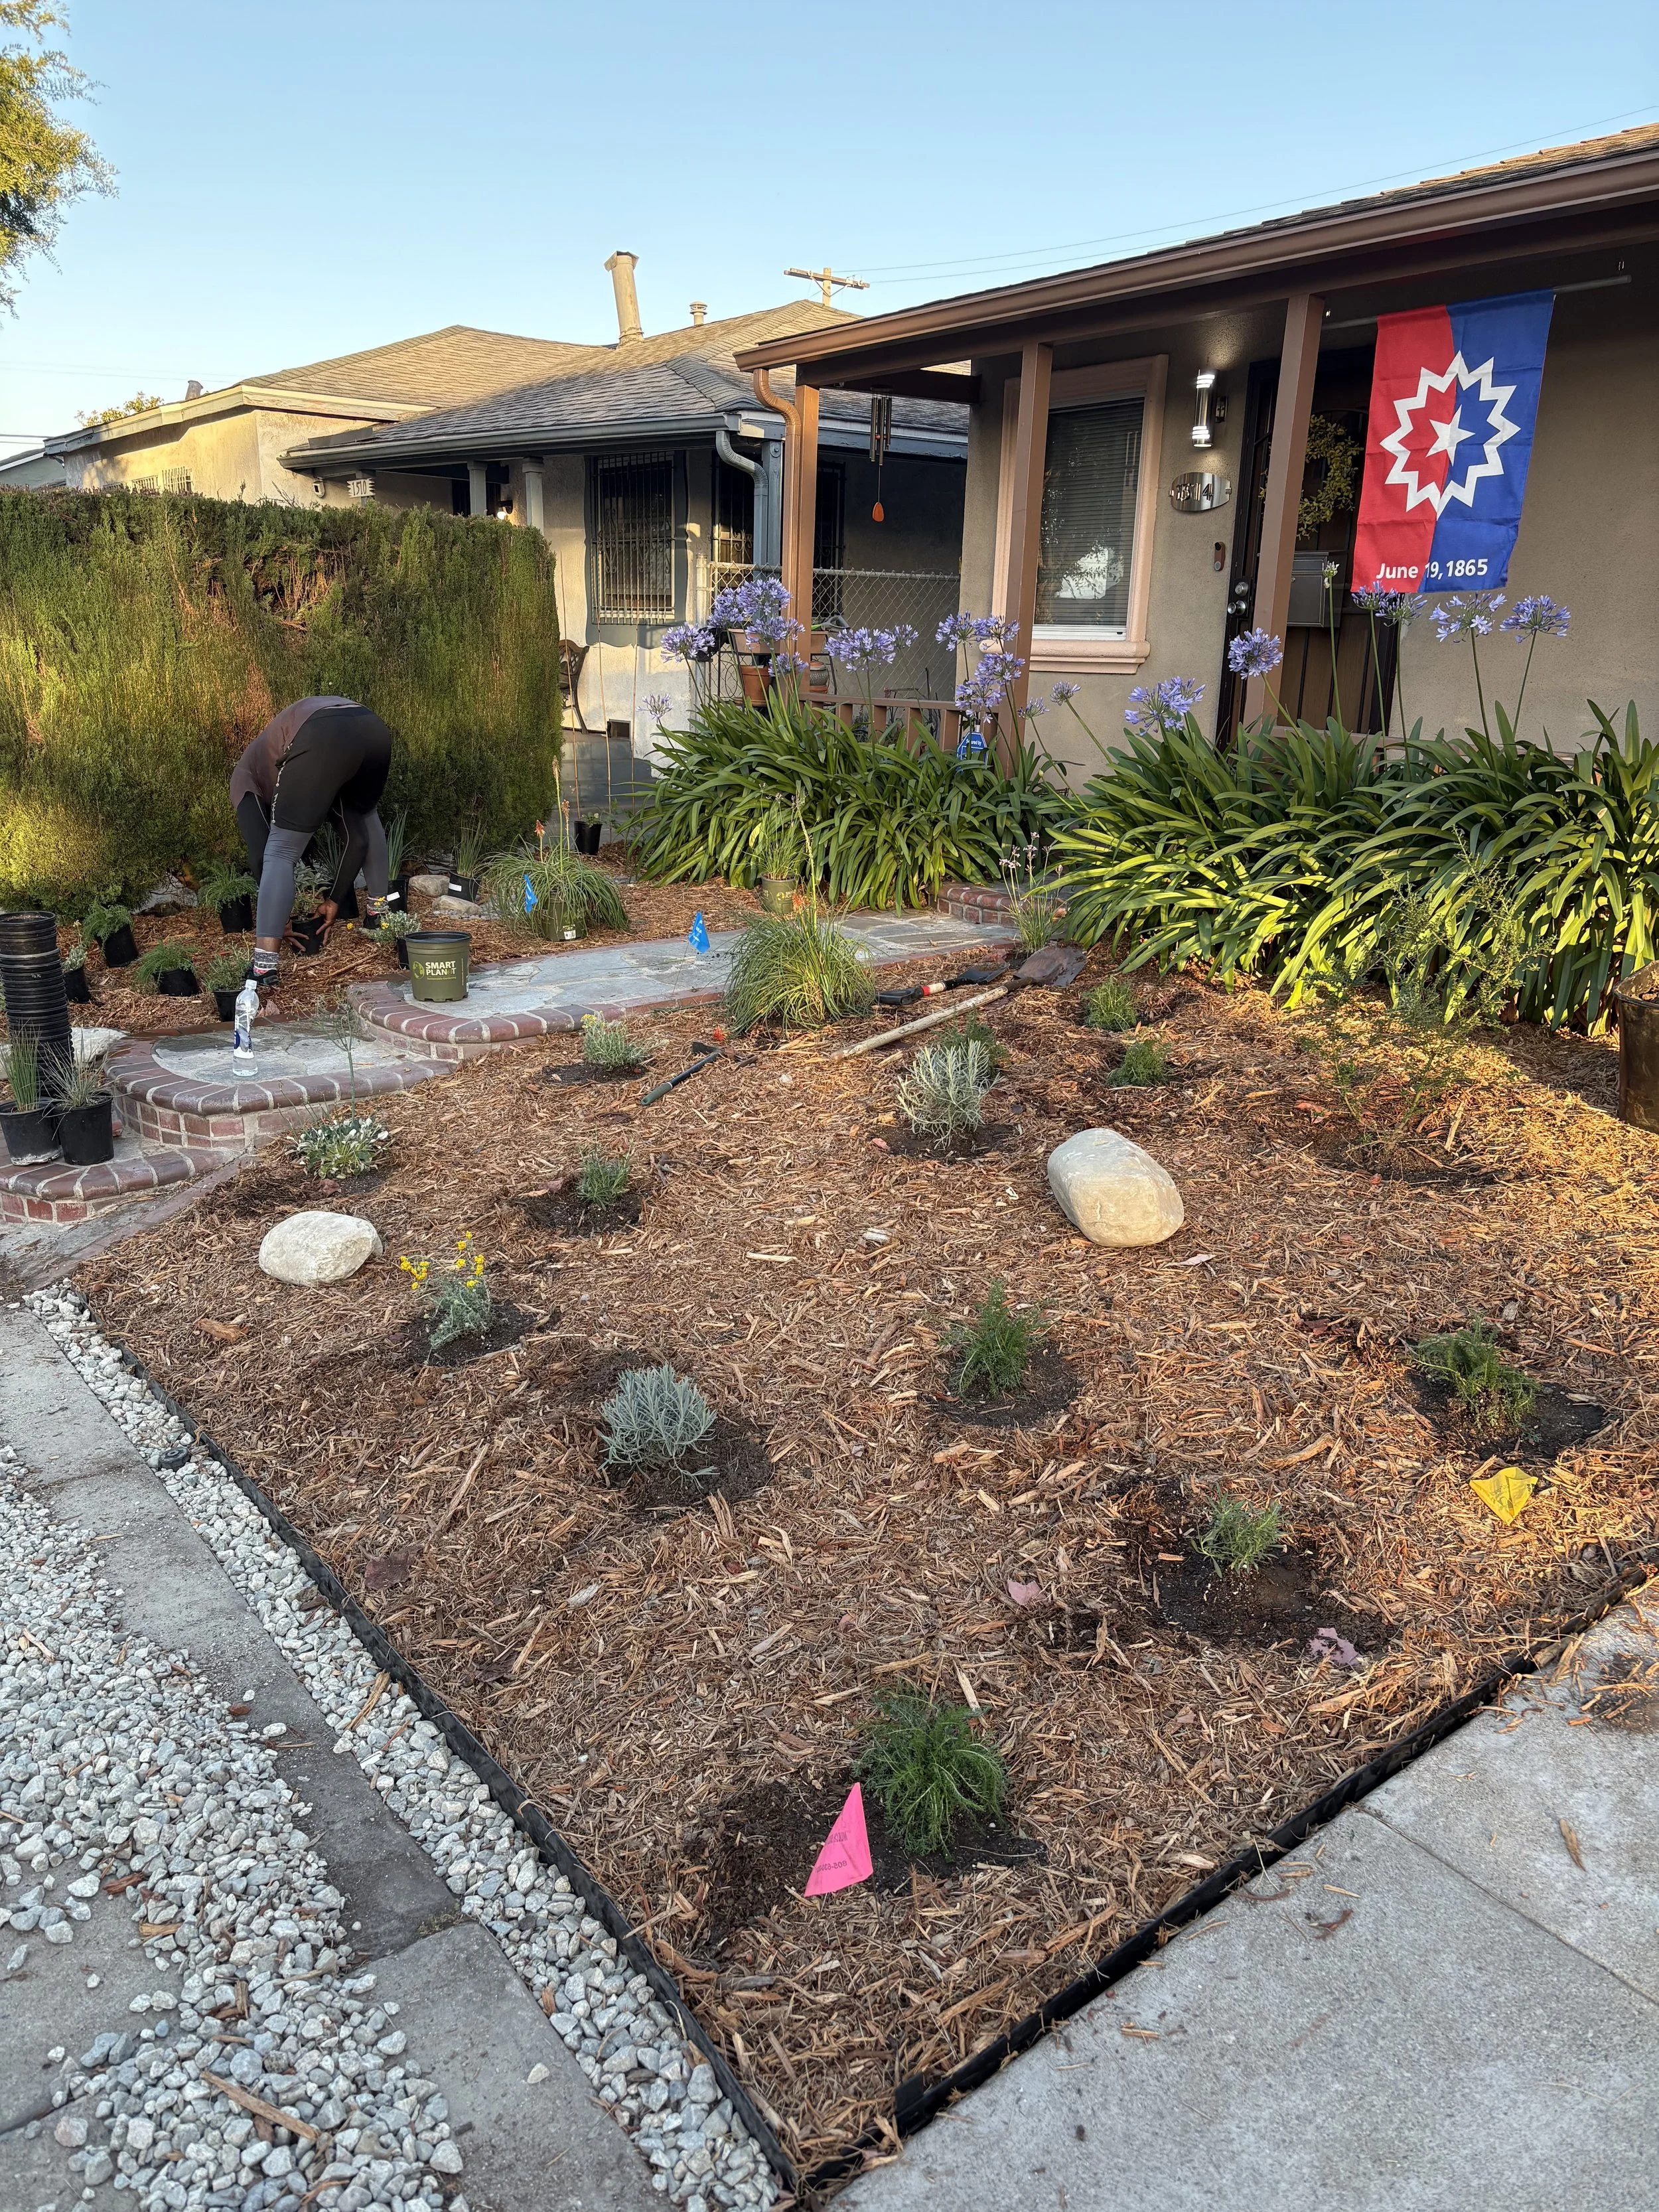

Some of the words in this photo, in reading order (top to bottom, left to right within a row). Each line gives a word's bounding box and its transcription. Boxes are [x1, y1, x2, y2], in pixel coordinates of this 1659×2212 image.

[352, 480, 367, 496] 1510
[1376, 563, 1419, 579] June
[1446, 558, 1488, 577] 1865
[425, 960, 456, 969] SMART
